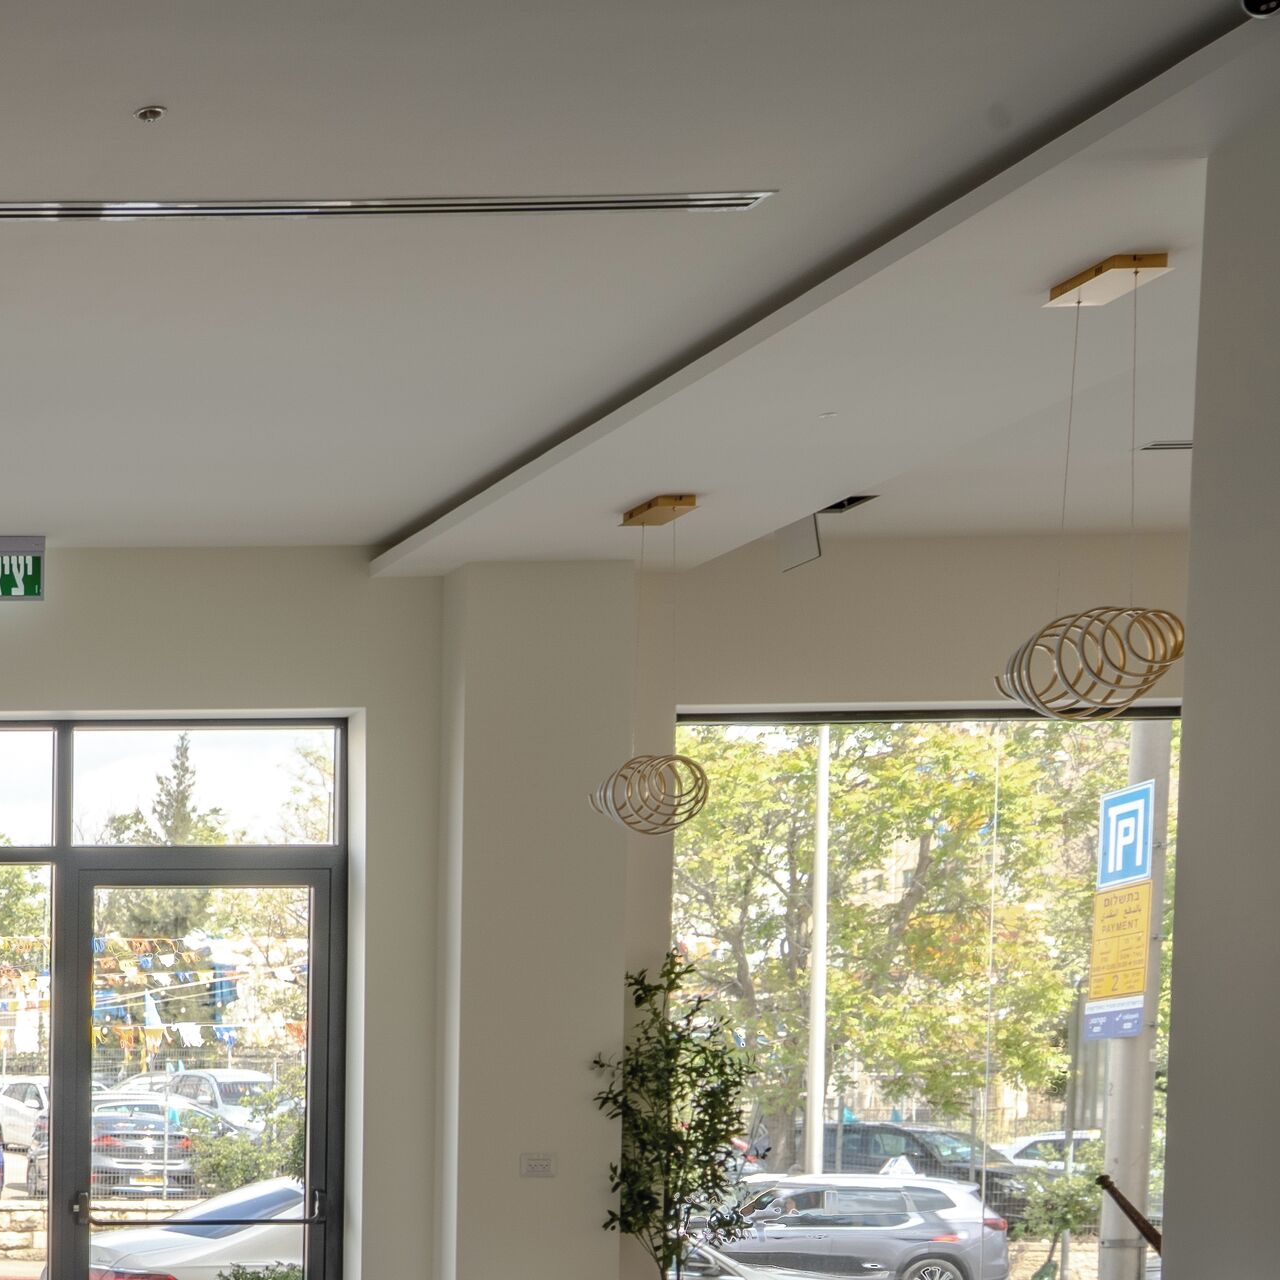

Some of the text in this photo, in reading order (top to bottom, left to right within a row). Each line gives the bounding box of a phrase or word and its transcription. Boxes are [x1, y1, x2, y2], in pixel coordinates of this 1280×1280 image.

[1103, 891, 1140, 908] בתשלום
[1101, 918, 1139, 933] PAYMENT
[1111, 974, 1120, 992] 2
